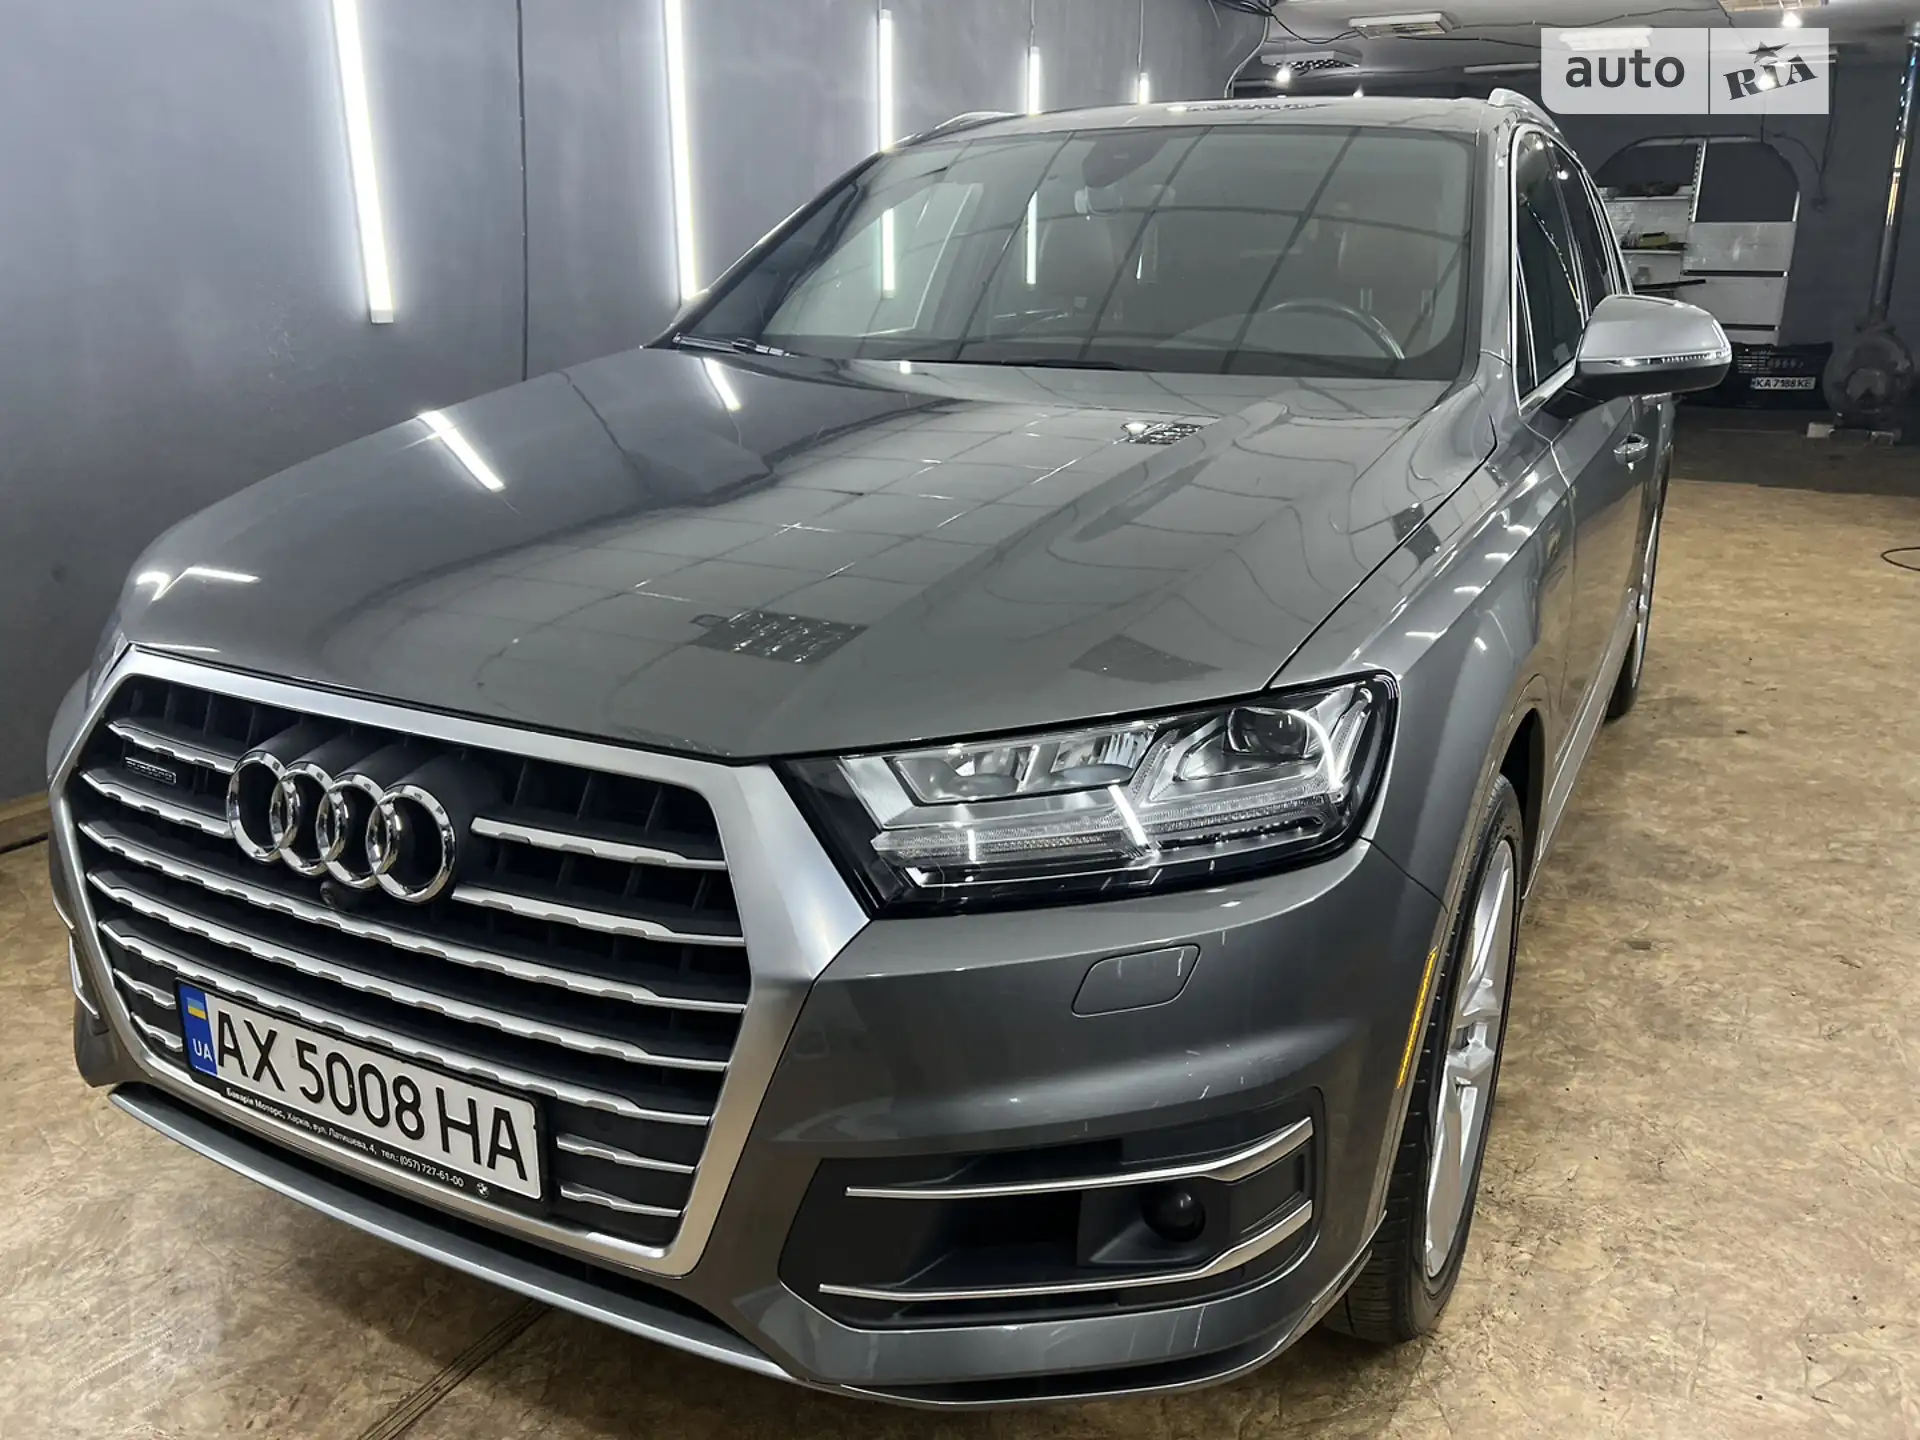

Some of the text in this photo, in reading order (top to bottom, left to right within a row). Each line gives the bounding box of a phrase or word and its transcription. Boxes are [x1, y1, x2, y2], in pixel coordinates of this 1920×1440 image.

[192, 1038, 213, 1063] UA
[218, 1010, 528, 1182] AX 5008 HA
[400, 1153, 421, 1172] (057)
[421, 1164, 465, 1188] 727-61-00
